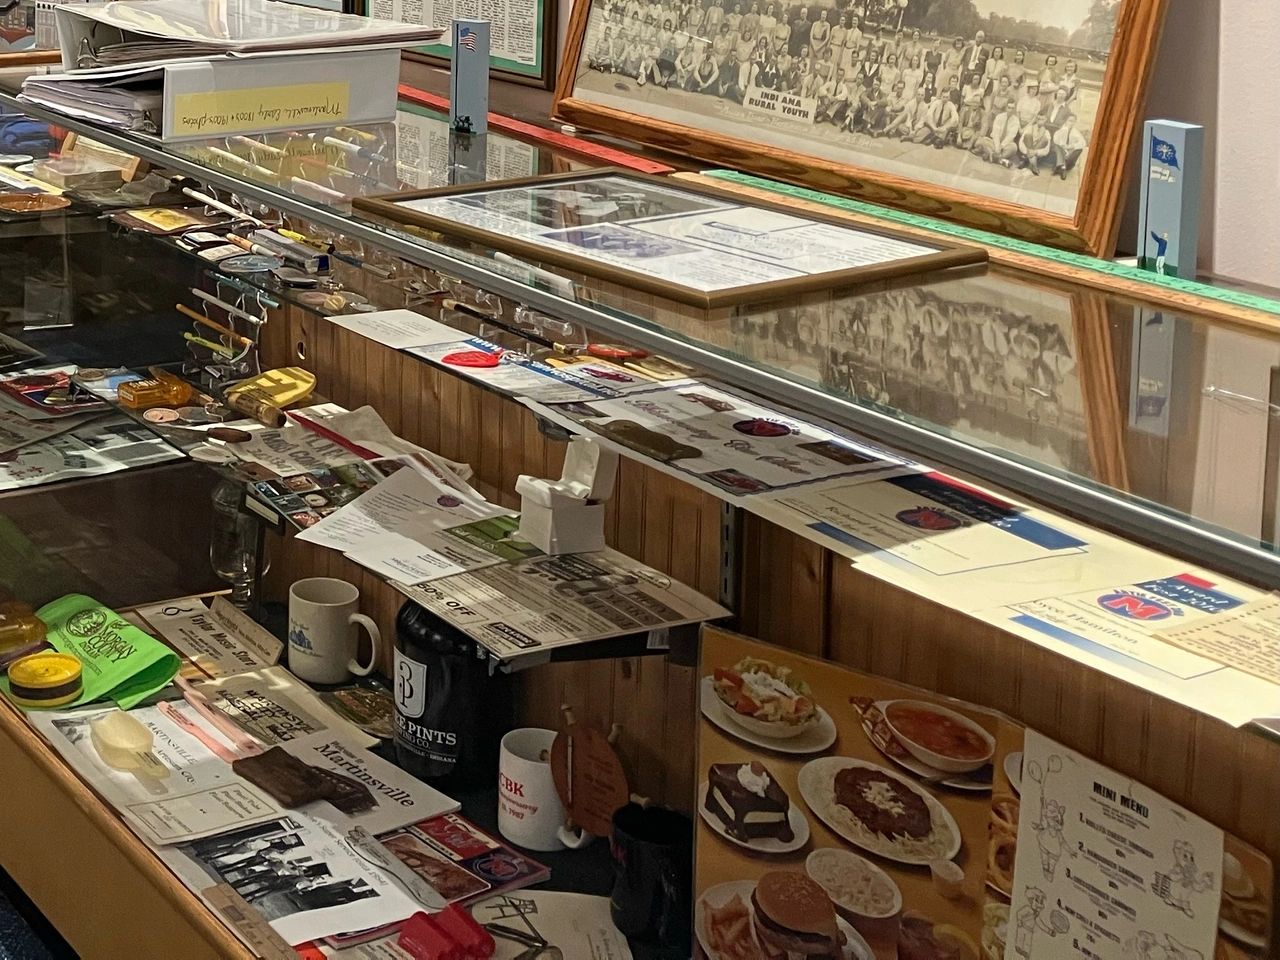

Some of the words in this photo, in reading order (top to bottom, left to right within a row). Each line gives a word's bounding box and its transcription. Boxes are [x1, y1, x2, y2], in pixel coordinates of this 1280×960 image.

[748, 97, 777, 111] RURAL
[782, 105, 810, 119] YOUTH
[446, 600, 477, 618] OFF
[408, 721, 457, 746] PINTS
[416, 739, 431, 750] CO.
[313, 743, 416, 808] Martinsville
[1093, 781, 1117, 803] MINI
[1120, 794, 1150, 819] MENU
